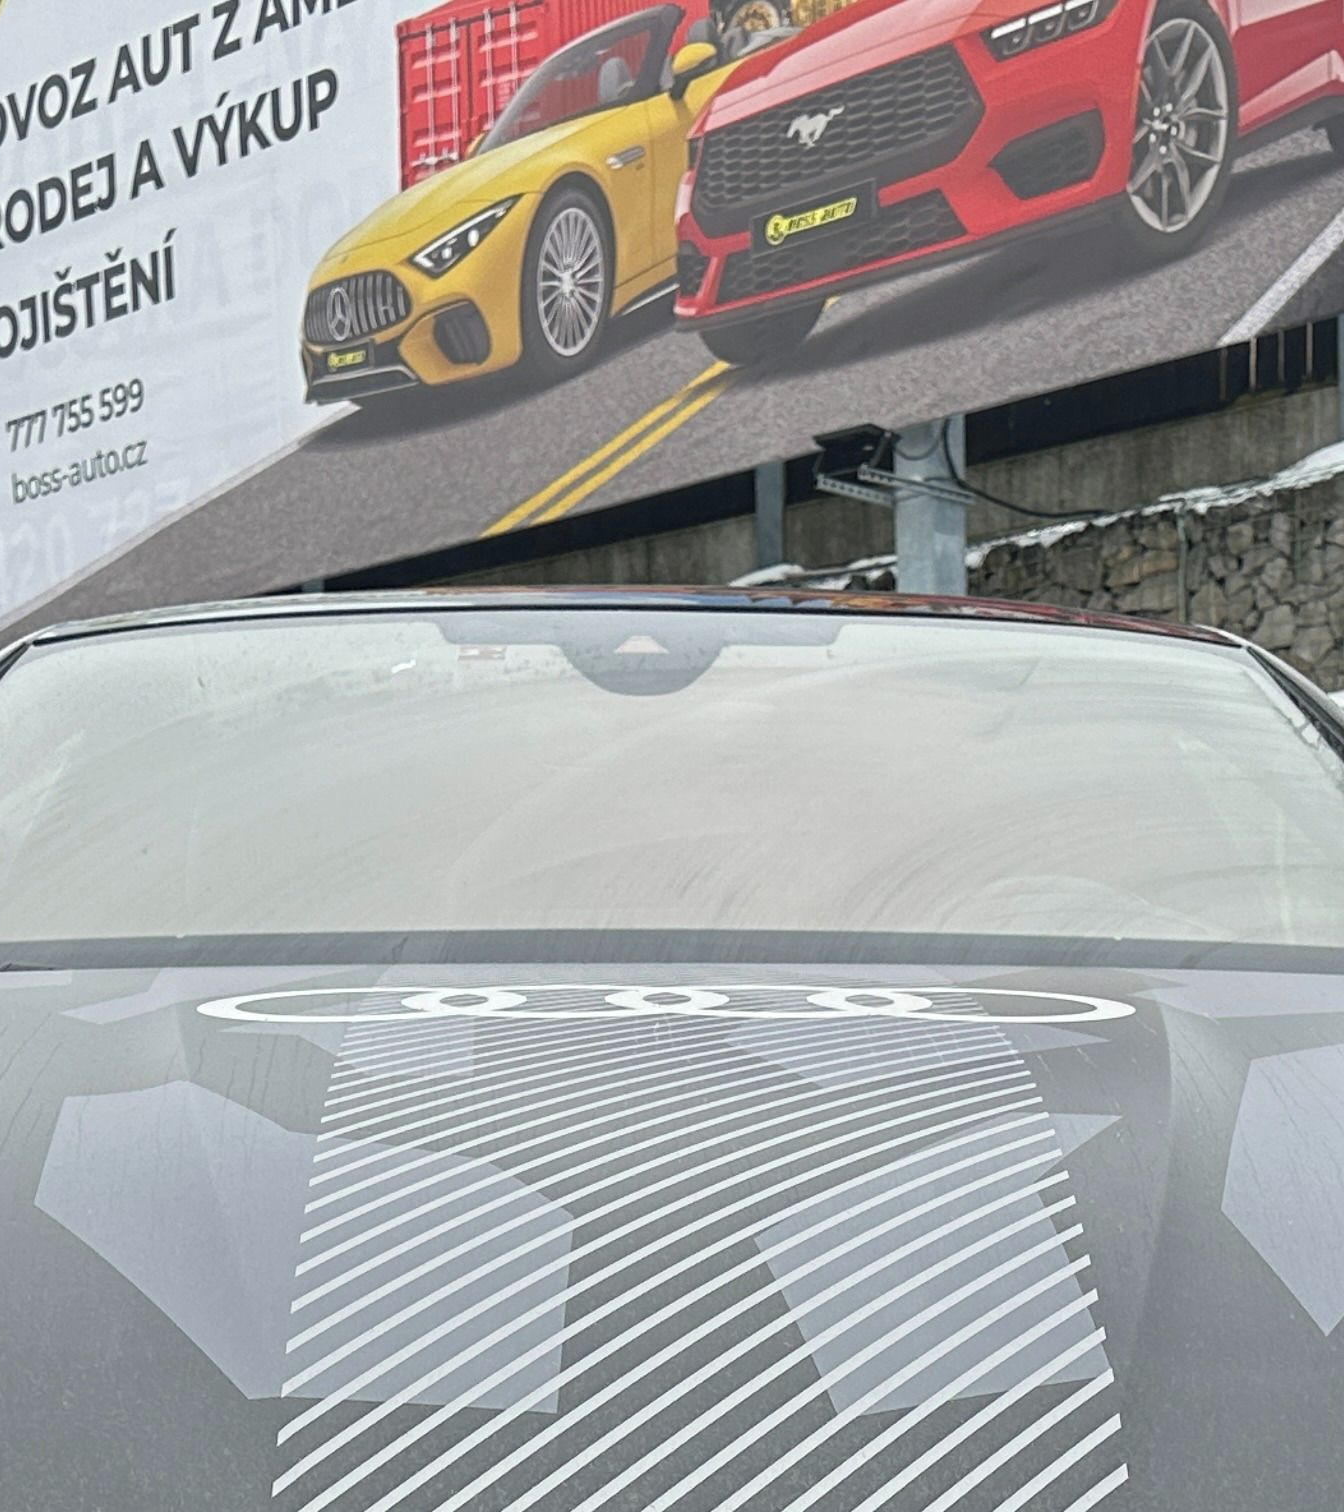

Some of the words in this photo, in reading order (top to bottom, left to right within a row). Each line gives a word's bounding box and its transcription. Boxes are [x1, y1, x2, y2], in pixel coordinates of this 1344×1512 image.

[107, 13, 200, 105] AUT
[212, 0, 242, 60] Z
[129, 138, 166, 200] A
[172, 67, 338, 178] VÝKUP
[6, 409, 47, 452] 777
[52, 394, 94, 437] 755
[100, 378, 144, 422] 599
[11, 440, 148, 504] boss-auto.cz
